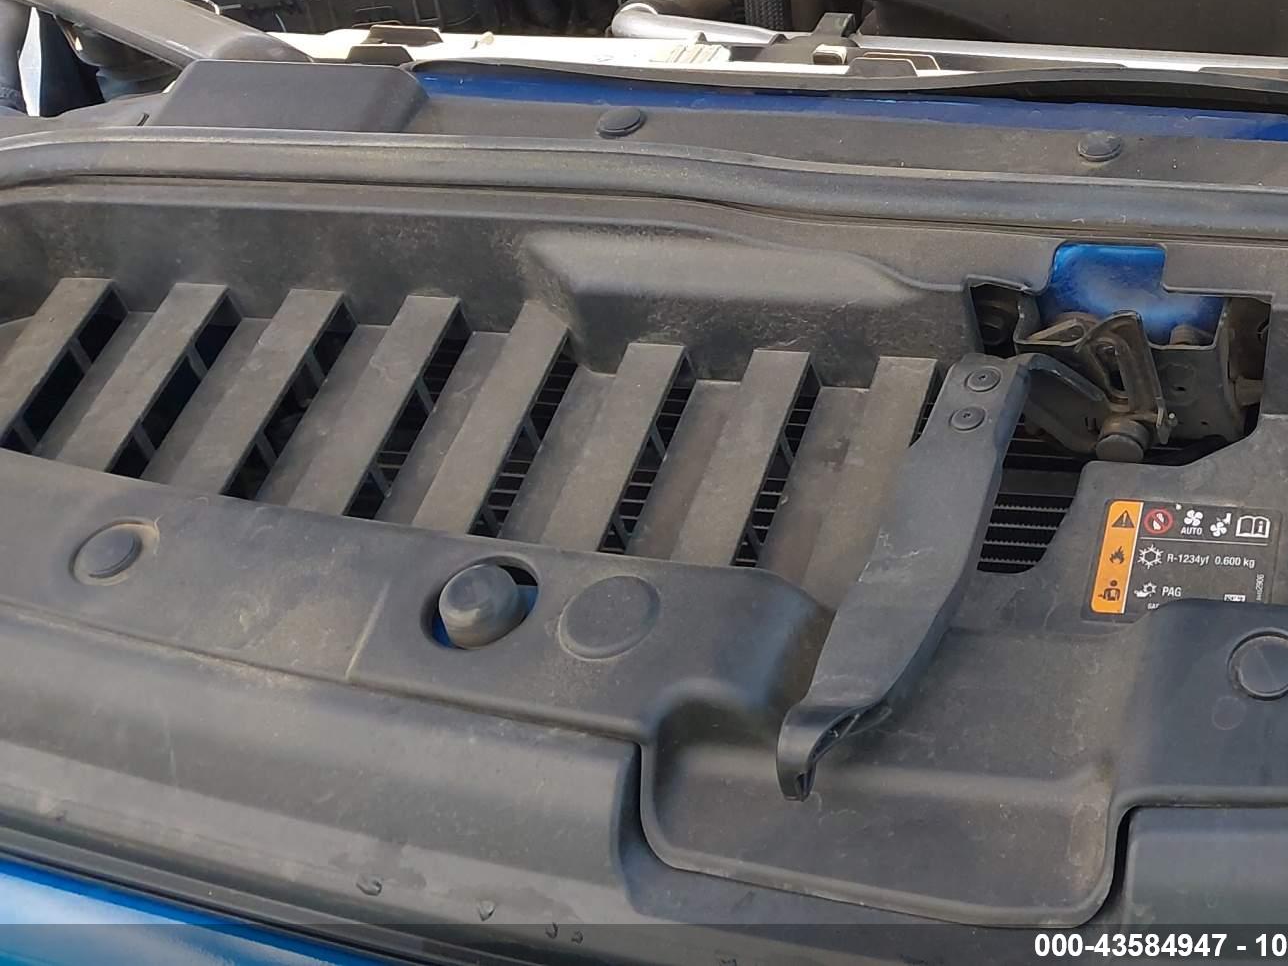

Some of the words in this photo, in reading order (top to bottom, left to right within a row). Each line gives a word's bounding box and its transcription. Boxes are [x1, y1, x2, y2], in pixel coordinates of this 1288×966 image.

[1180, 526, 1203, 535] AUTO
[1166, 553, 1210, 566] R-1234yf
[1214, 555, 1241, 566] 0.600
[1243, 557, 1256, 569] kg
[1161, 586, 1182, 597] PAG
